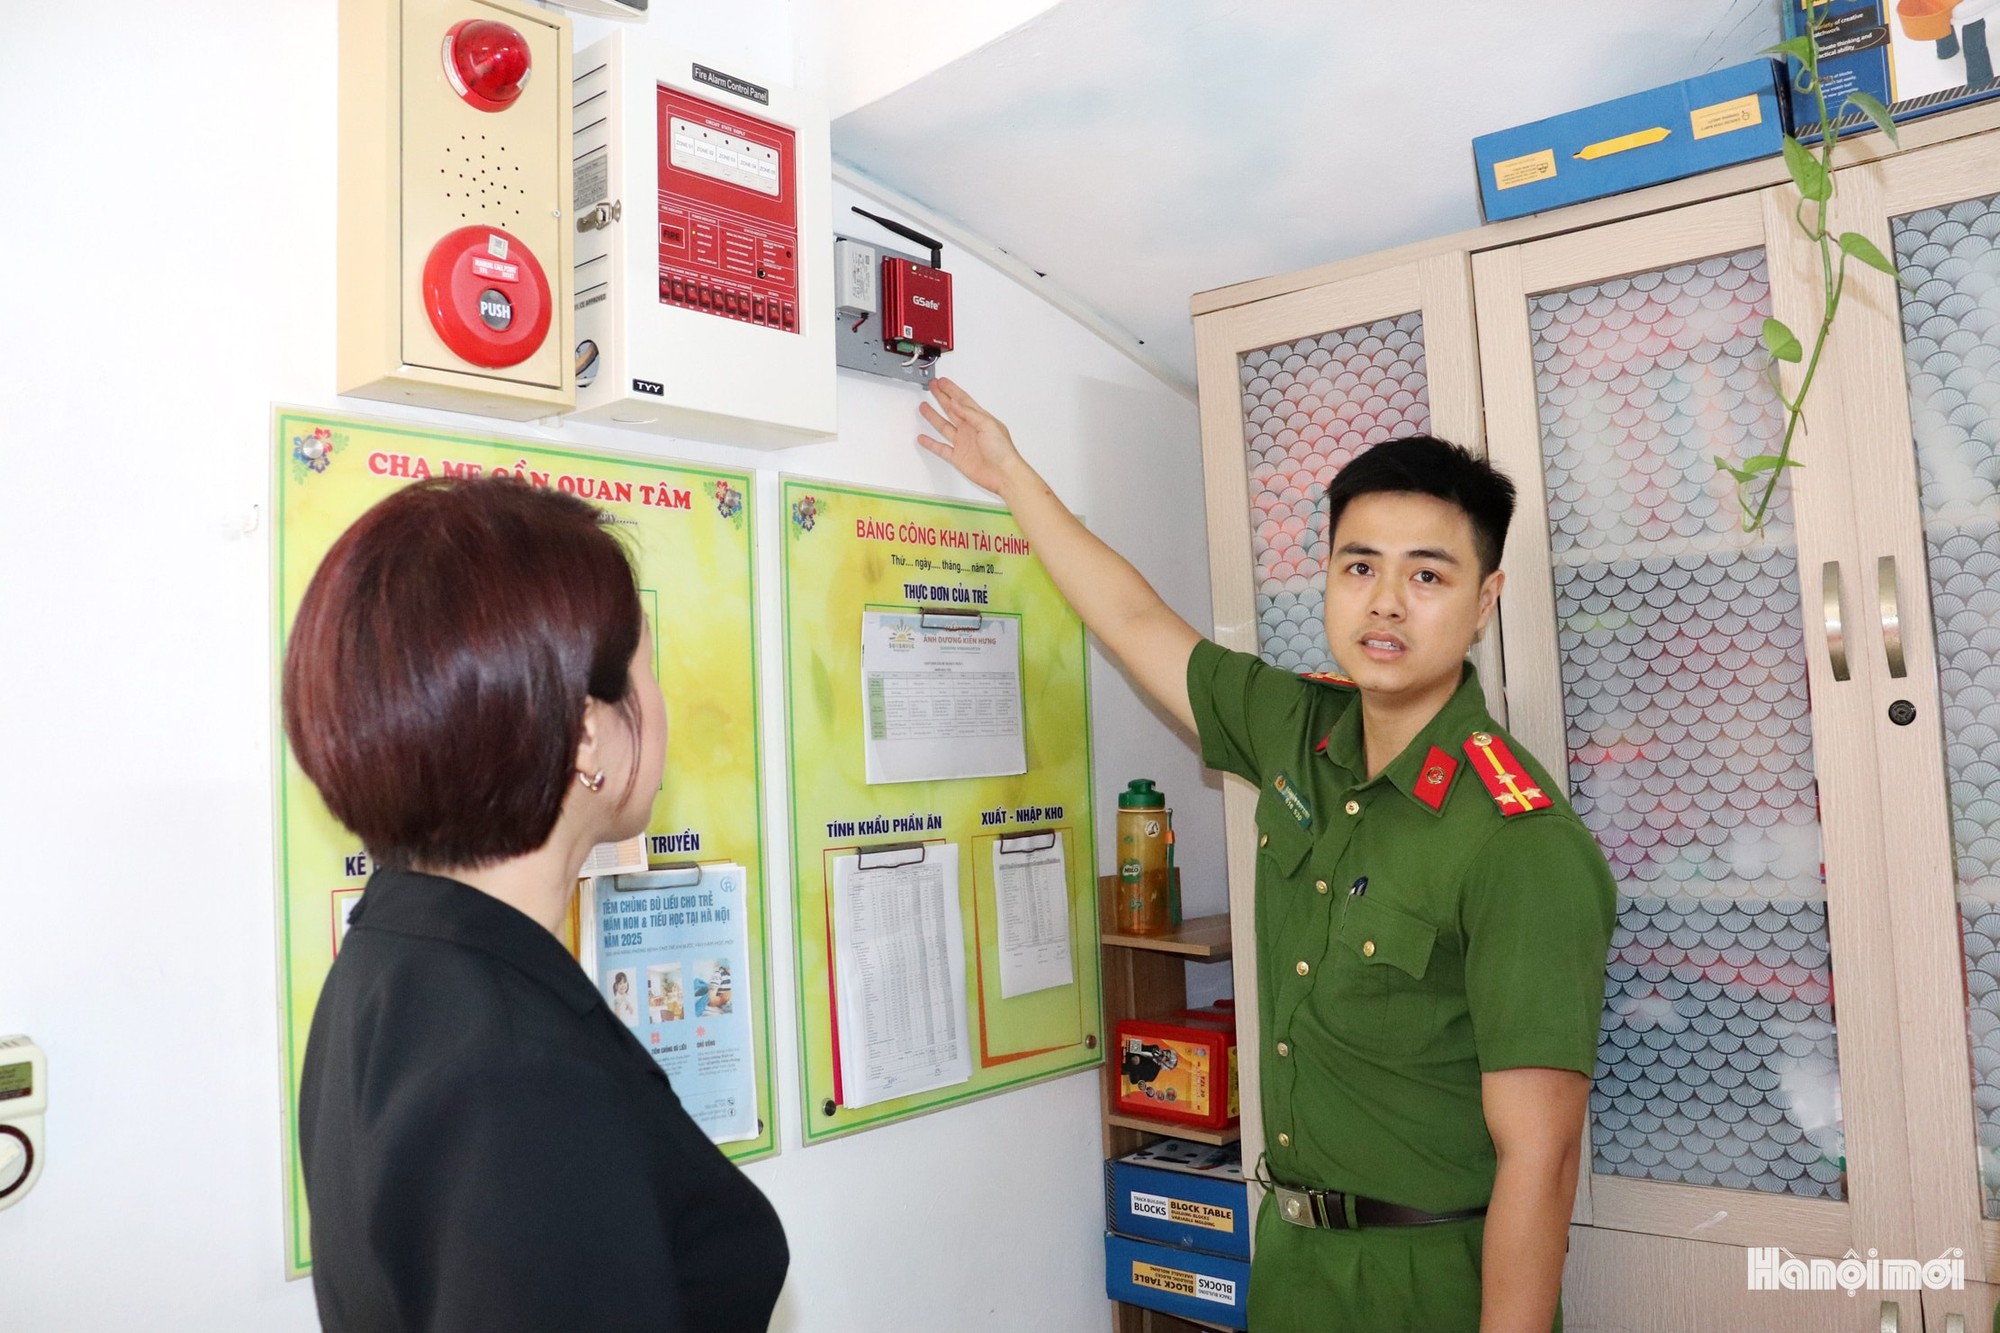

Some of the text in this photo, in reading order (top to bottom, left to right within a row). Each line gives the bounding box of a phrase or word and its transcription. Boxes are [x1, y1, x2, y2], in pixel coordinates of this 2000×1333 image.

[1841, 13, 1863, 23] creative
[1814, 26, 1840, 38] atchwork
[1837, 36, 1861, 47] thinking
[1861, 32, 1872, 40] and
[1837, 45, 1855, 54] ability
[695, 67, 767, 101] Fire Alarm Control Panel
[663, 229, 680, 242] FIRE
[480, 301, 511, 319] PUSH
[912, 295, 938, 311] GSafe
[637, 381, 660, 392] TYY
[368, 452, 431, 480] CHA
[557, 475, 633, 503] QUAN
[639, 481, 692, 510] TÂM
[856, 516, 1030, 556] BẢNG CÔNG KHAI TÀI CHÍNH
[971, 564, 985, 573] năm
[904, 582, 988, 604] THỰC ĐƠN CỦA TRẺ
[981, 806, 1007, 826] XUẤT
[1016, 806, 1042, 824] NHẬP
[1045, 806, 1063, 820] KHO
[827, 813, 942, 838] TÍNH KHẨU PHẦN ĂN
[652, 828, 700, 854] TRUYỀN
[681, 895, 696, 909] CHO
[698, 890, 713, 907] TRẺ
[623, 916, 639, 930] NON
[642, 917, 647, 928] &
[669, 912, 684, 928] HỌC
[686, 911, 698, 927] TẠI
[701, 907, 712, 923] HÀ
[715, 906, 730, 924] NỘI
[621, 932, 642, 947] 2025
[1134, 1202, 1166, 1216] BLOCKS
[1170, 1201, 1232, 1219] BLOCK TABLE
[1134, 1273, 1193, 1293] BLOCK TABLE
[1199, 1278, 1232, 1293] BLOCKS
